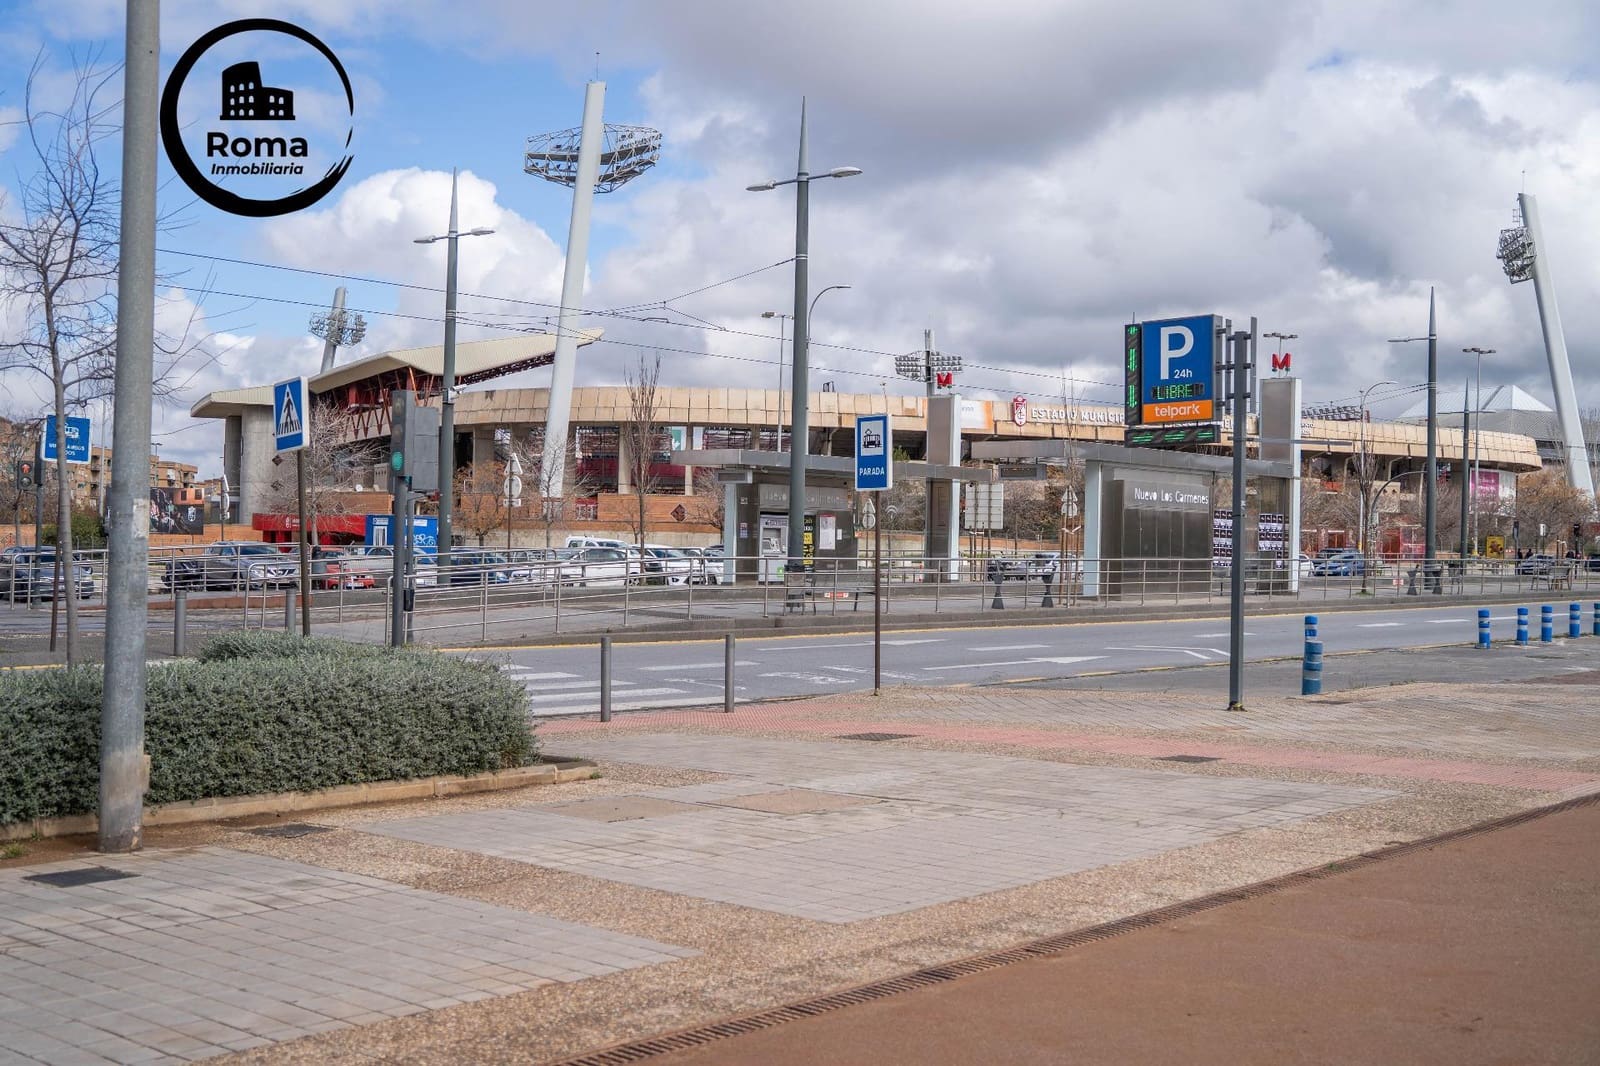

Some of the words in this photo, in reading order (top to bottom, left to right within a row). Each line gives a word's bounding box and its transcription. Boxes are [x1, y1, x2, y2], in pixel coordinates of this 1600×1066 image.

[1160, 325, 1194, 380] P
[1271, 353, 1291, 370] M
[936, 371, 953, 387] M
[1173, 368, 1193, 379] 24h
[1031, 407, 1078, 420] ESTADIO
[1081, 411, 1125, 425] MUNICIP
[1154, 403, 1201, 419] telpark
[859, 466, 885, 476] PARADA
[1134, 487, 1158, 501] Nuevo
[1161, 490, 1173, 502] Los
